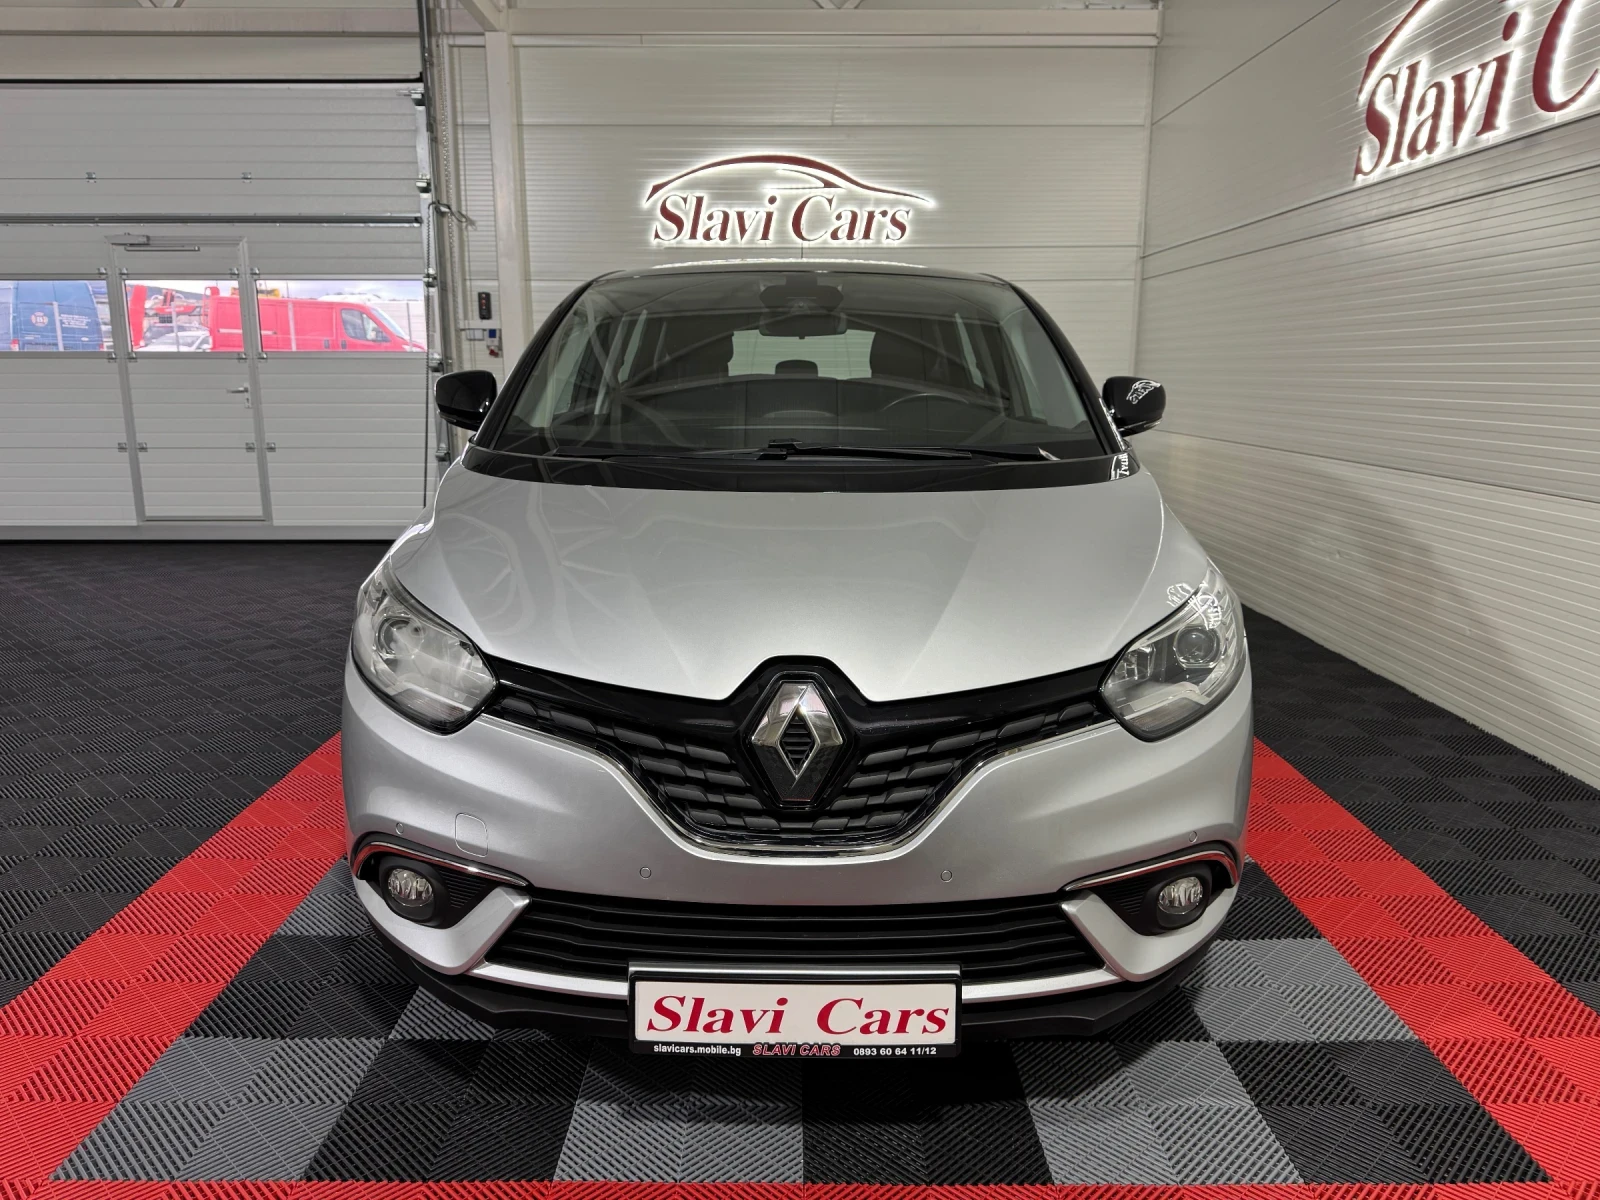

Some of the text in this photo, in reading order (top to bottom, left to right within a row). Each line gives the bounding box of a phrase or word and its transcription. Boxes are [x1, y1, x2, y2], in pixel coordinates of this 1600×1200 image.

[1353, 11, 1520, 181] Slavi
[653, 194, 912, 242] Slavi Cars
[646, 995, 950, 1036] Slavi Cars
[653, 1043, 742, 1057] slavicars.mobile.bg
[752, 1043, 841, 1057] SLAVI CARS
[853, 1046, 938, 1056] 0893 60 64 11/12
